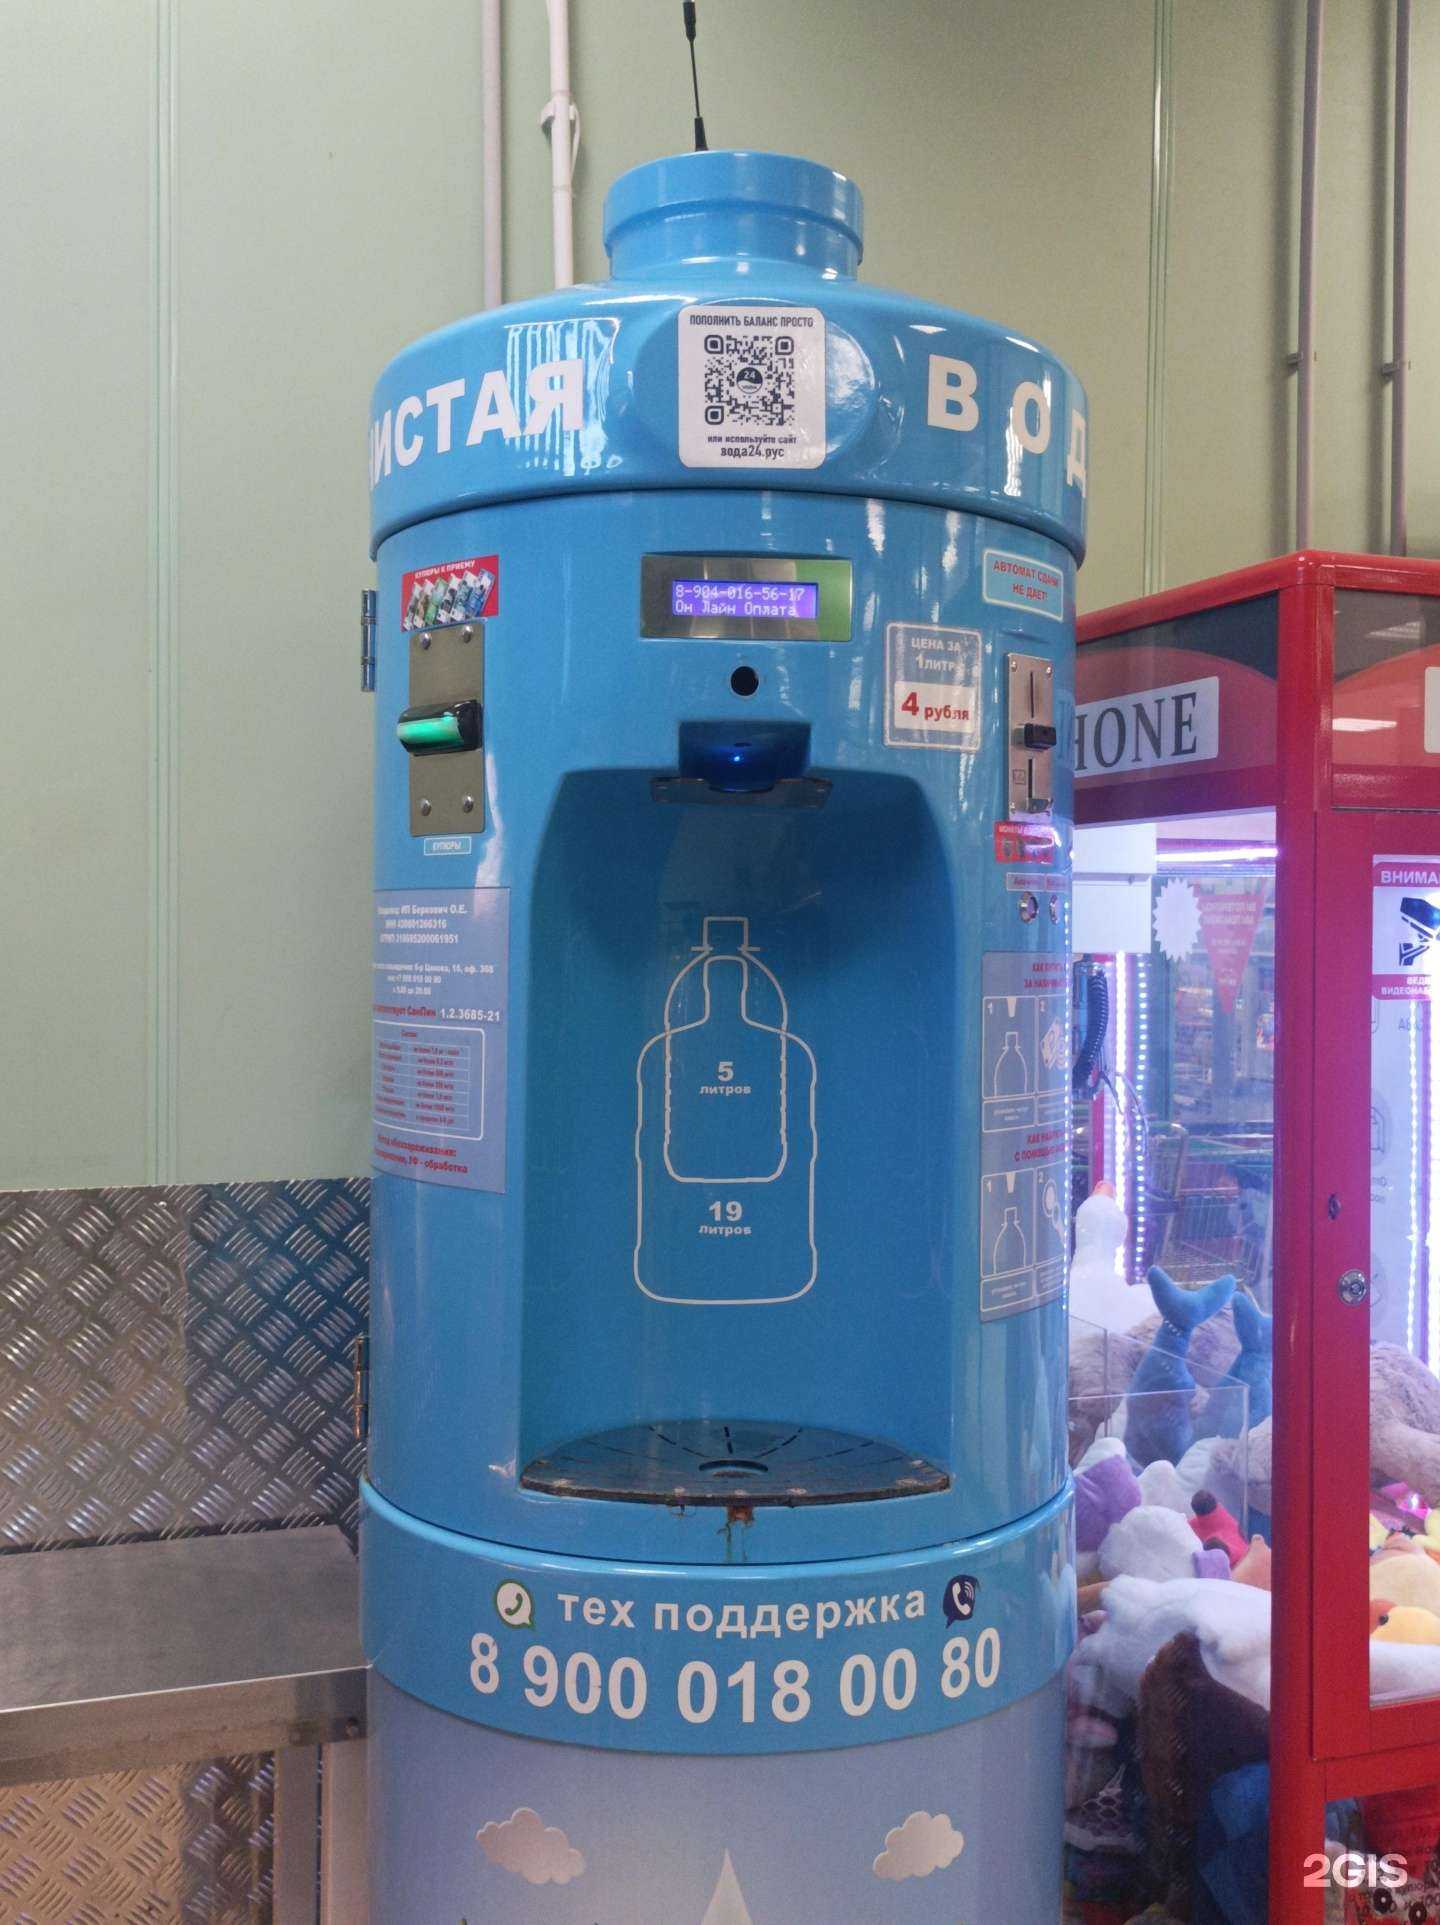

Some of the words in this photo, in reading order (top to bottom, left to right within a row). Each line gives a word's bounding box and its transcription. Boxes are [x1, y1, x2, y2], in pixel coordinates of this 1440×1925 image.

[689, 315, 741, 327] ПОПОЛНИТЬ
[743, 316, 778, 328] БАЛАНС
[780, 317, 814, 328] ПРОСТО
[369, 359, 584, 490] ИСТАЯ
[707, 436, 723, 444] или
[725, 434, 776, 447] используйте
[778, 435, 797, 444] сайт
[720, 445, 785, 460] вода24.рус
[992, 560, 1036, 579] АВТОМАТ
[1012, 583, 1025, 596] НЕ
[675, 601, 693, 614] Он
[702, 601, 736, 615] Лайн
[744, 602, 798, 617] Оплата
[911, 637, 945, 650] ЦЕНА
[947, 641, 962, 653] ЗА
[901, 692, 920, 716] 4
[924, 705, 970, 721] рубля
[440, 1008, 500, 1021] 1.2.3685-21
[717, 1061, 734, 1082] 5
[699, 1084, 752, 1096] литров
[709, 1201, 743, 1222] 19
[699, 1225, 752, 1238] литров
[557, 1592, 635, 1630] тех
[654, 1587, 927, 1639] поддержка
[469, 1632, 499, 1695] 8
[523, 1644, 648, 1720] 900
[676, 1658, 812, 1724] 018
[839, 1647, 918, 1718] 00
[940, 1626, 1002, 1699] 80
